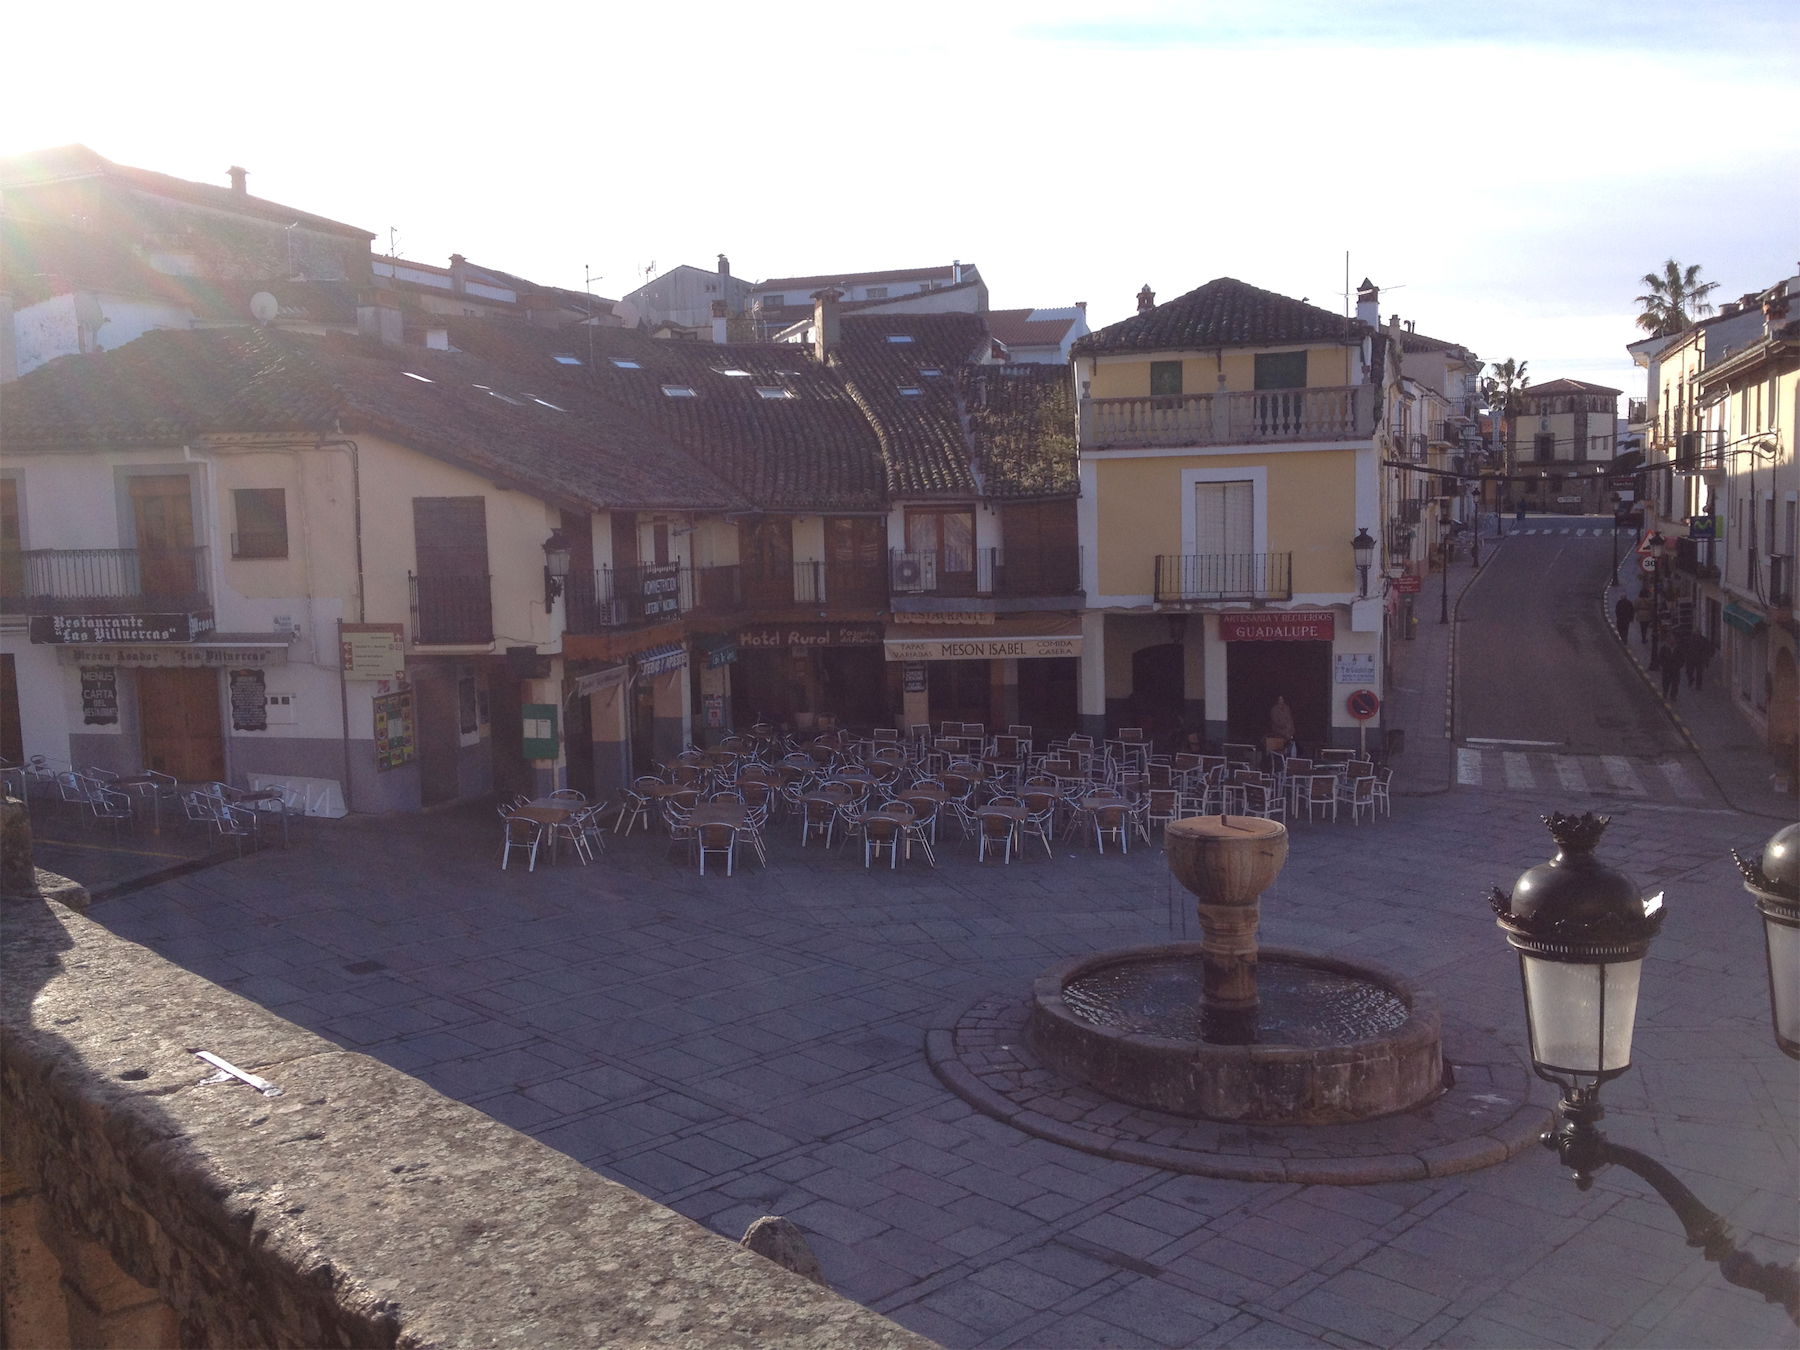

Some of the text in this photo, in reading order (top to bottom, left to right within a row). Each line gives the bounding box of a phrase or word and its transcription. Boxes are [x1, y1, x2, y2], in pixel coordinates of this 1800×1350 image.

[54, 616, 144, 628] Restaurante
[1236, 626, 1319, 637] GUADALUPE
[741, 630, 830, 646] Hotel Rural
[942, 643, 1026, 656] MESON ISABEL
[1036, 640, 1073, 648] COMIDA
[83, 671, 114, 681] MENUS
[84, 689, 115, 699] CARTA
